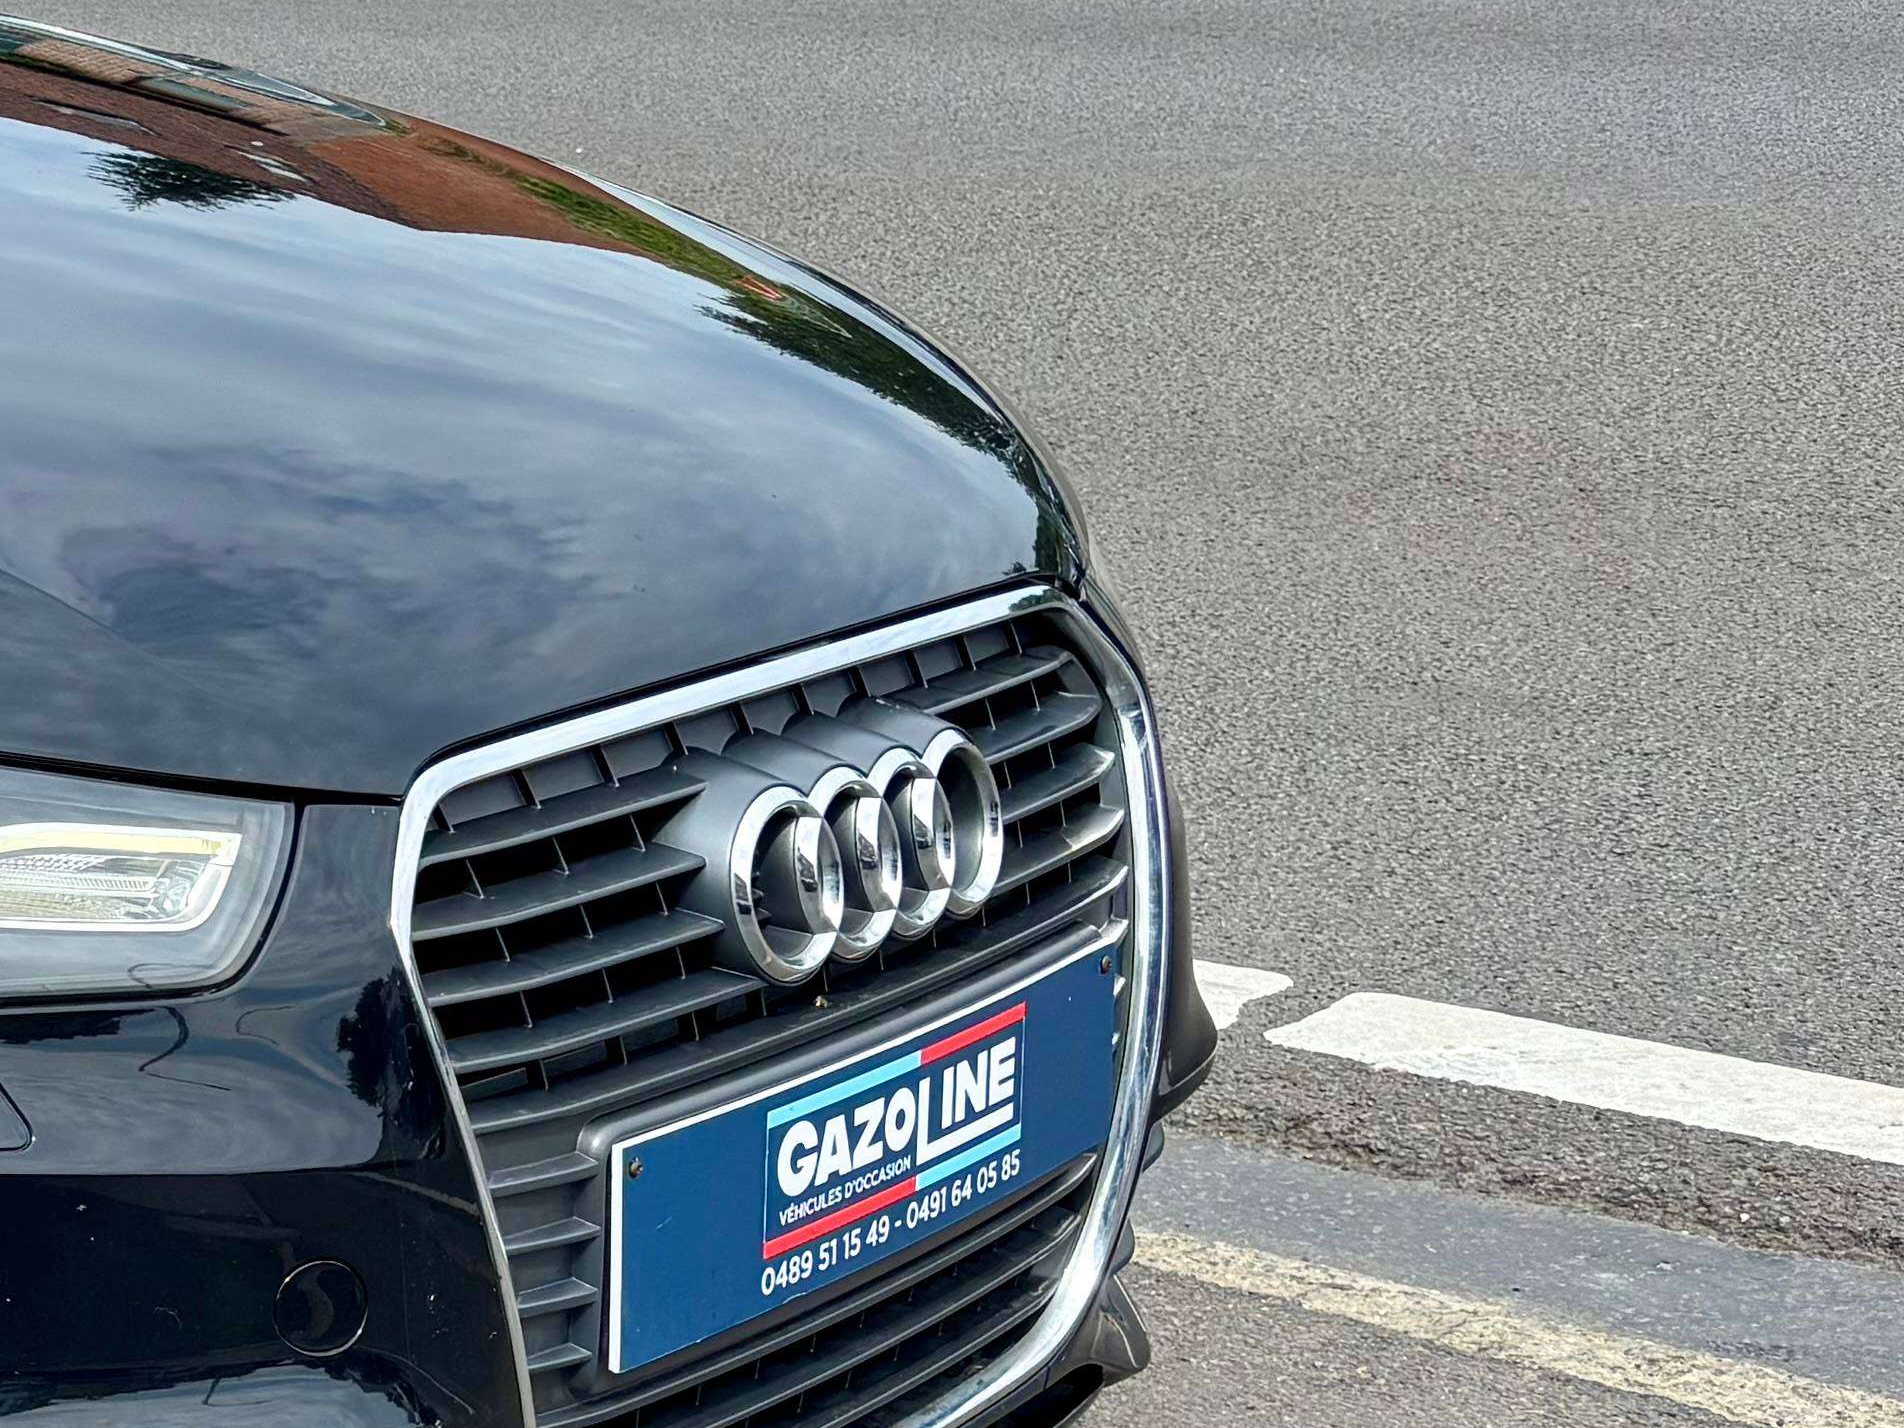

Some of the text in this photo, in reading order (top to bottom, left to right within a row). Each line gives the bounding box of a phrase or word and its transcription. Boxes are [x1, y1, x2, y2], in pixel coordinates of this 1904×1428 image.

[777, 1036, 1016, 1196] GAZOLINE
[761, 1250, 813, 1295] 0489
[818, 1238, 837, 1271] 51
[843, 1227, 861, 1260] 15
[866, 1215, 890, 1247] 49
[906, 1186, 947, 1229] 0491
[952, 1174, 973, 1207] 64
[976, 1160, 997, 1194] 05
[1001, 1149, 1021, 1181] 85
[779, 1155, 911, 1226] VÉHICULES D'OCCASION
